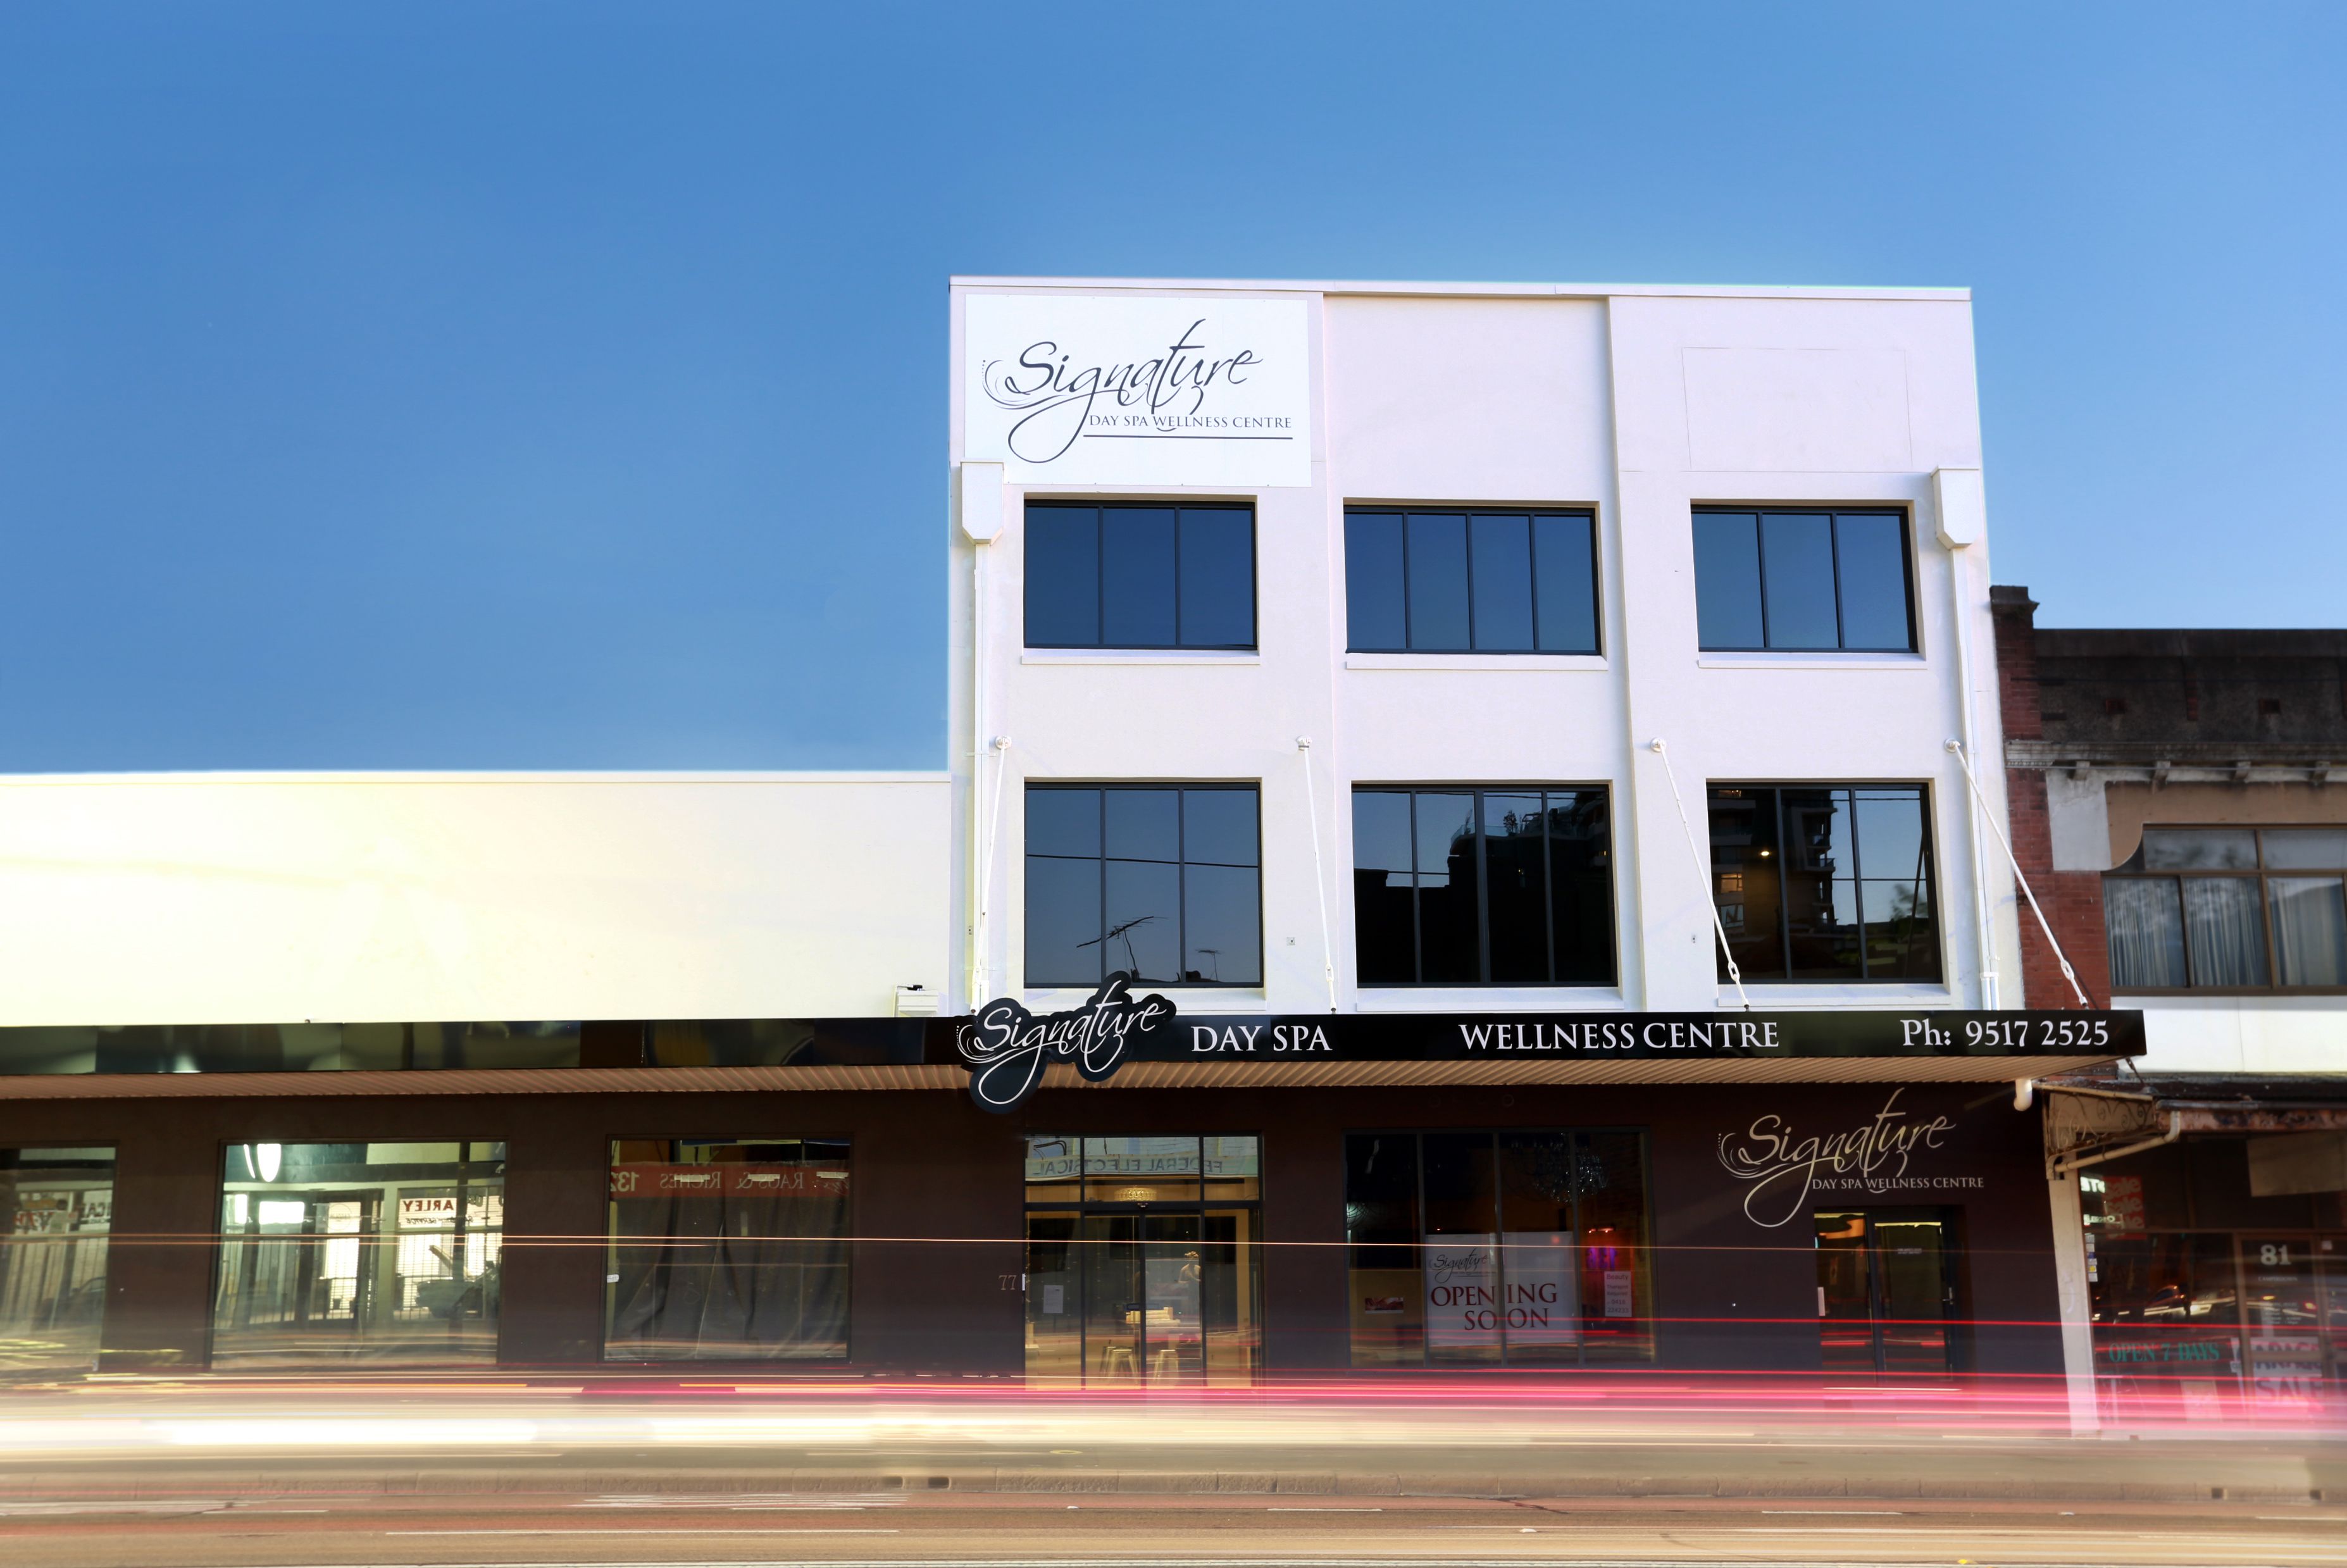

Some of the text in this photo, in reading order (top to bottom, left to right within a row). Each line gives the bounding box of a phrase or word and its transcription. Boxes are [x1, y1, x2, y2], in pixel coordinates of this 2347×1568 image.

[982, 318, 1263, 463] Signature
[1090, 414, 1292, 428] DAY SPA WELLNESS CENTRE
[956, 980, 2109, 1104] Signature DAY SPA WELLNESS CENTRE Ph: 9517 2525
[1717, 1087, 1957, 1227] Signature
[1812, 1177, 1984, 1190] DAY SPA WELLNESS CENTRE
[2260, 1243, 2291, 1266] 81
[998, 1274, 1017, 1290] 77
[1430, 1283, 1557, 1307] OPENING
[1464, 1307, 1549, 1331] SOON
[2108, 1341, 2220, 1362] OPEN 7 DAYS
